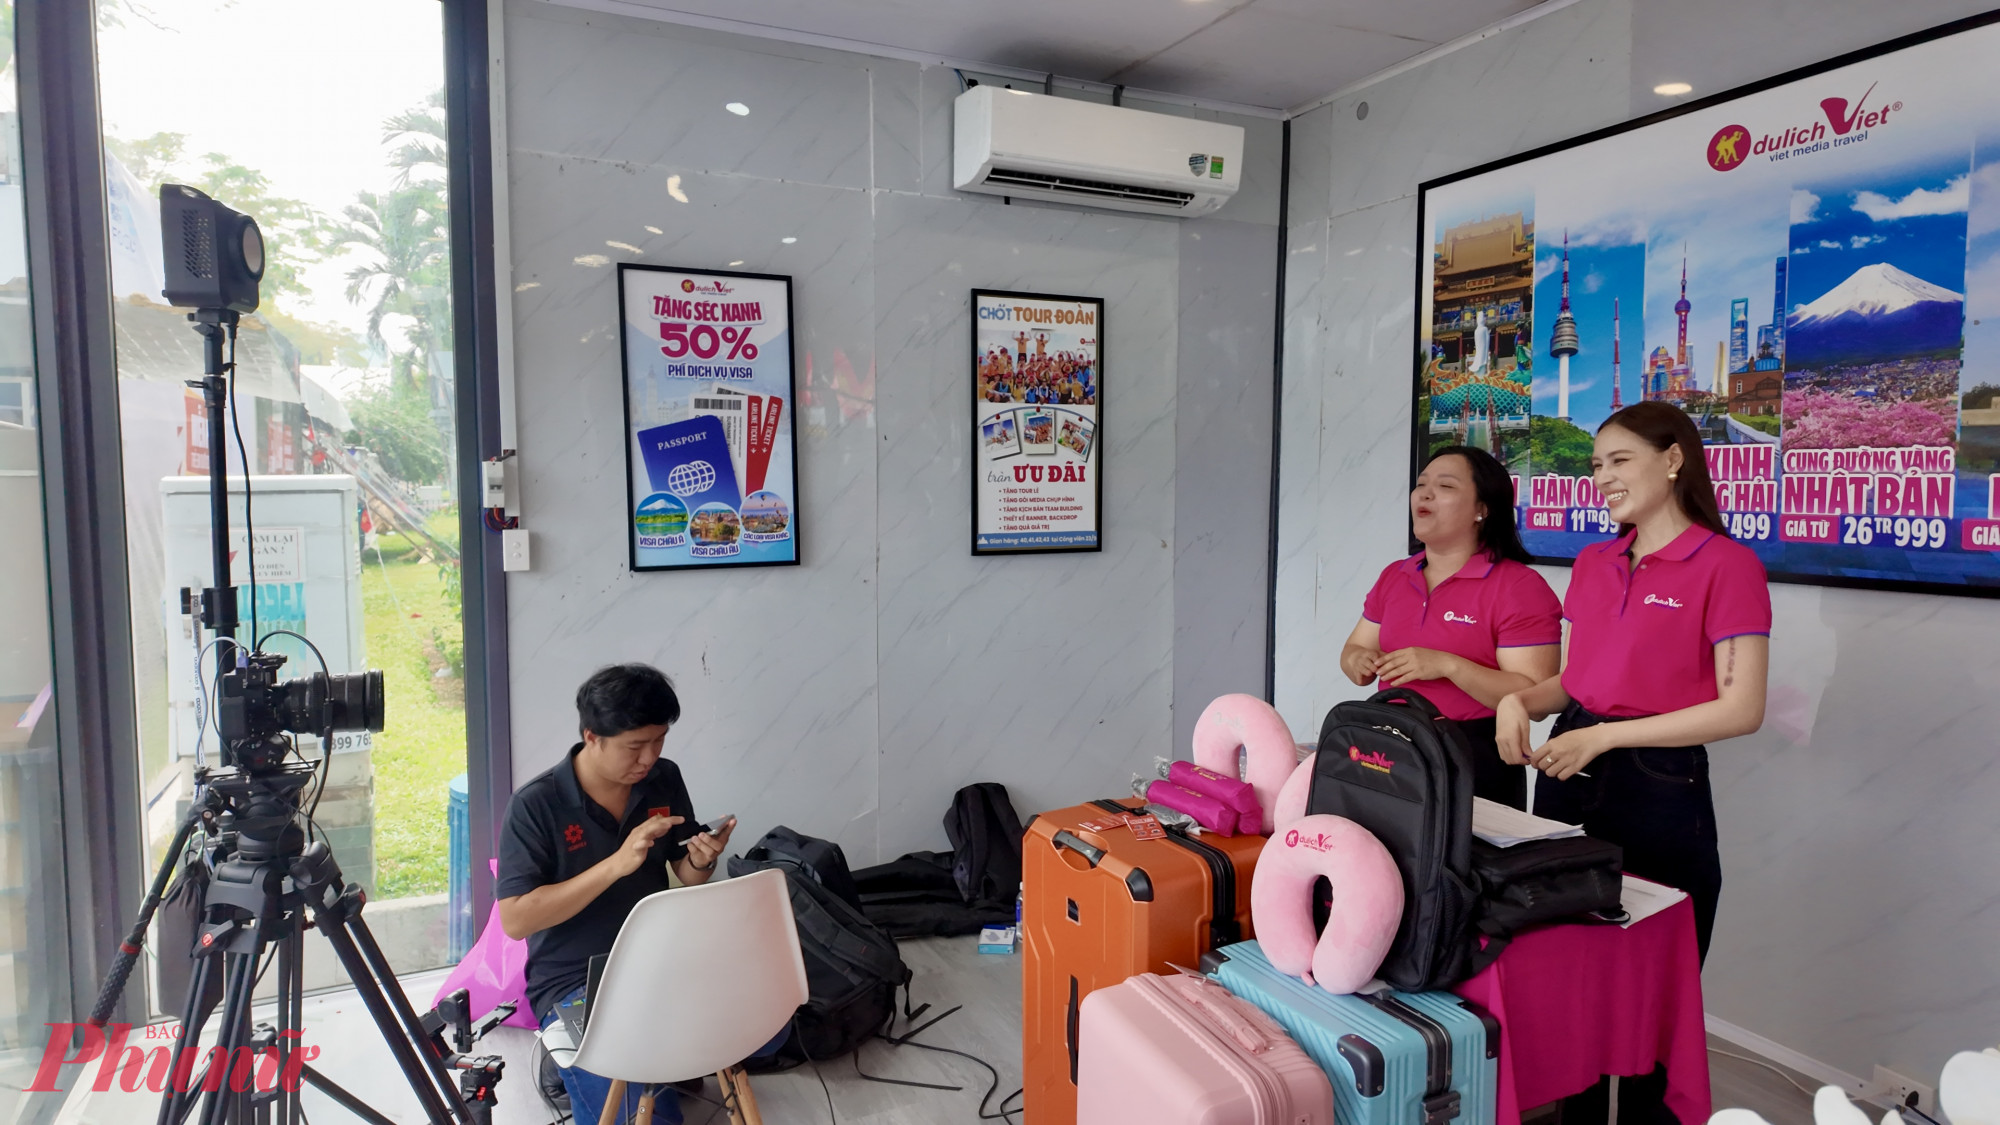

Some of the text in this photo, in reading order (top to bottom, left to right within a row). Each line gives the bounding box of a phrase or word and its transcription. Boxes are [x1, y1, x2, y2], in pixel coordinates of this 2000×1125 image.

[1769, 130, 1867, 162] viet media travel
[694, 300, 719, 322] SÉC
[721, 301, 762, 322] XANH
[979, 304, 1094, 325] CHỐT TOUR ĐOÀN
[660, 323, 759, 360] 50%
[668, 363, 753, 380] PHÍ DỊCH VỤ VISA
[657, 431, 708, 450] PASSPORT
[1704, 446, 1773, 480] KINH
[1786, 448, 1951, 472] CUNG ĐƯỜNG VÀNG
[987, 461, 1086, 483] tràn ƯU ĐÃI
[1532, 475, 1573, 507] HÀN
[1577, 477, 1606, 508] QU
[1735, 478, 1775, 512] HẢI
[1877, 469, 1952, 517] BẢN
[1533, 512, 1548, 527] GIÁ
[1550, 511, 1563, 528] TỪ
[1785, 519, 1808, 538] GIÁ
[1809, 519, 1830, 538] TỪ
[640, 537, 657, 546] VISA
[692, 546, 708, 555] VISA
